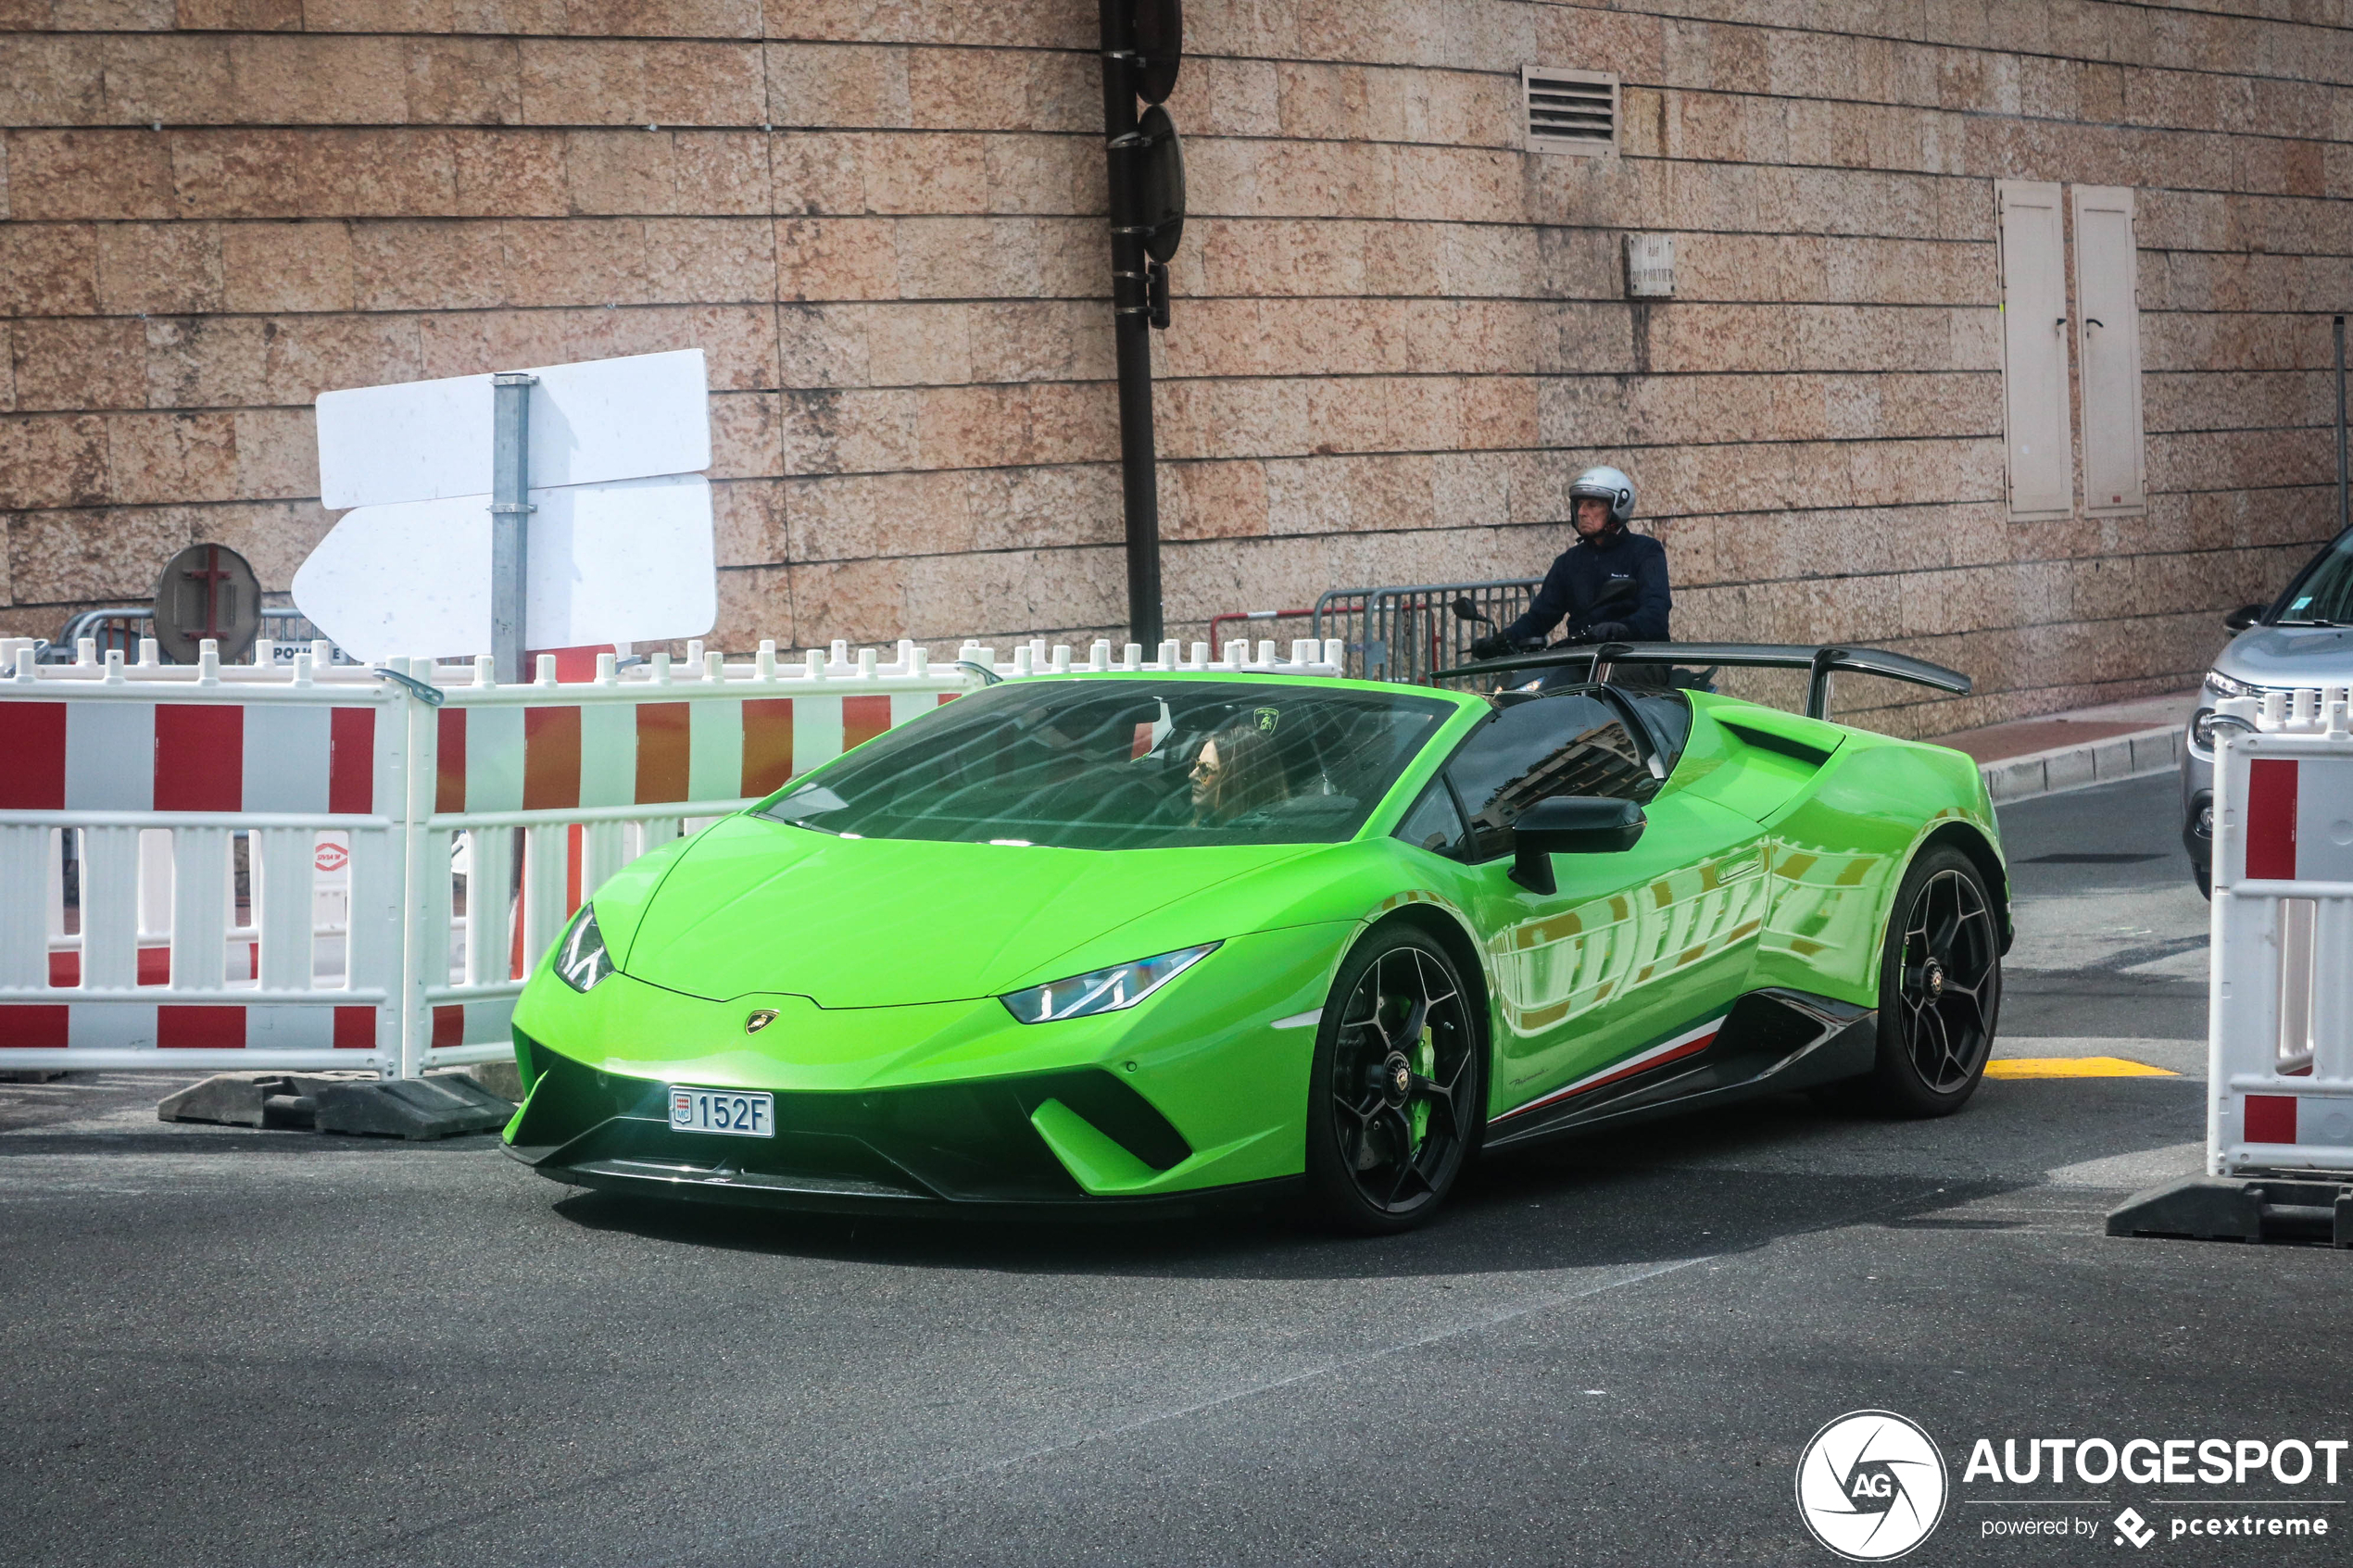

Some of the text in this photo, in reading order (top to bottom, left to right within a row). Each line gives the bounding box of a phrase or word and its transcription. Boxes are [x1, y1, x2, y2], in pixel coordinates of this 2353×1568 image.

[1632, 269, 1673, 282] DU PORTIER
[273, 647, 340, 659] POE
[677, 1110, 689, 1120] MC
[699, 1095, 767, 1131] 152F
